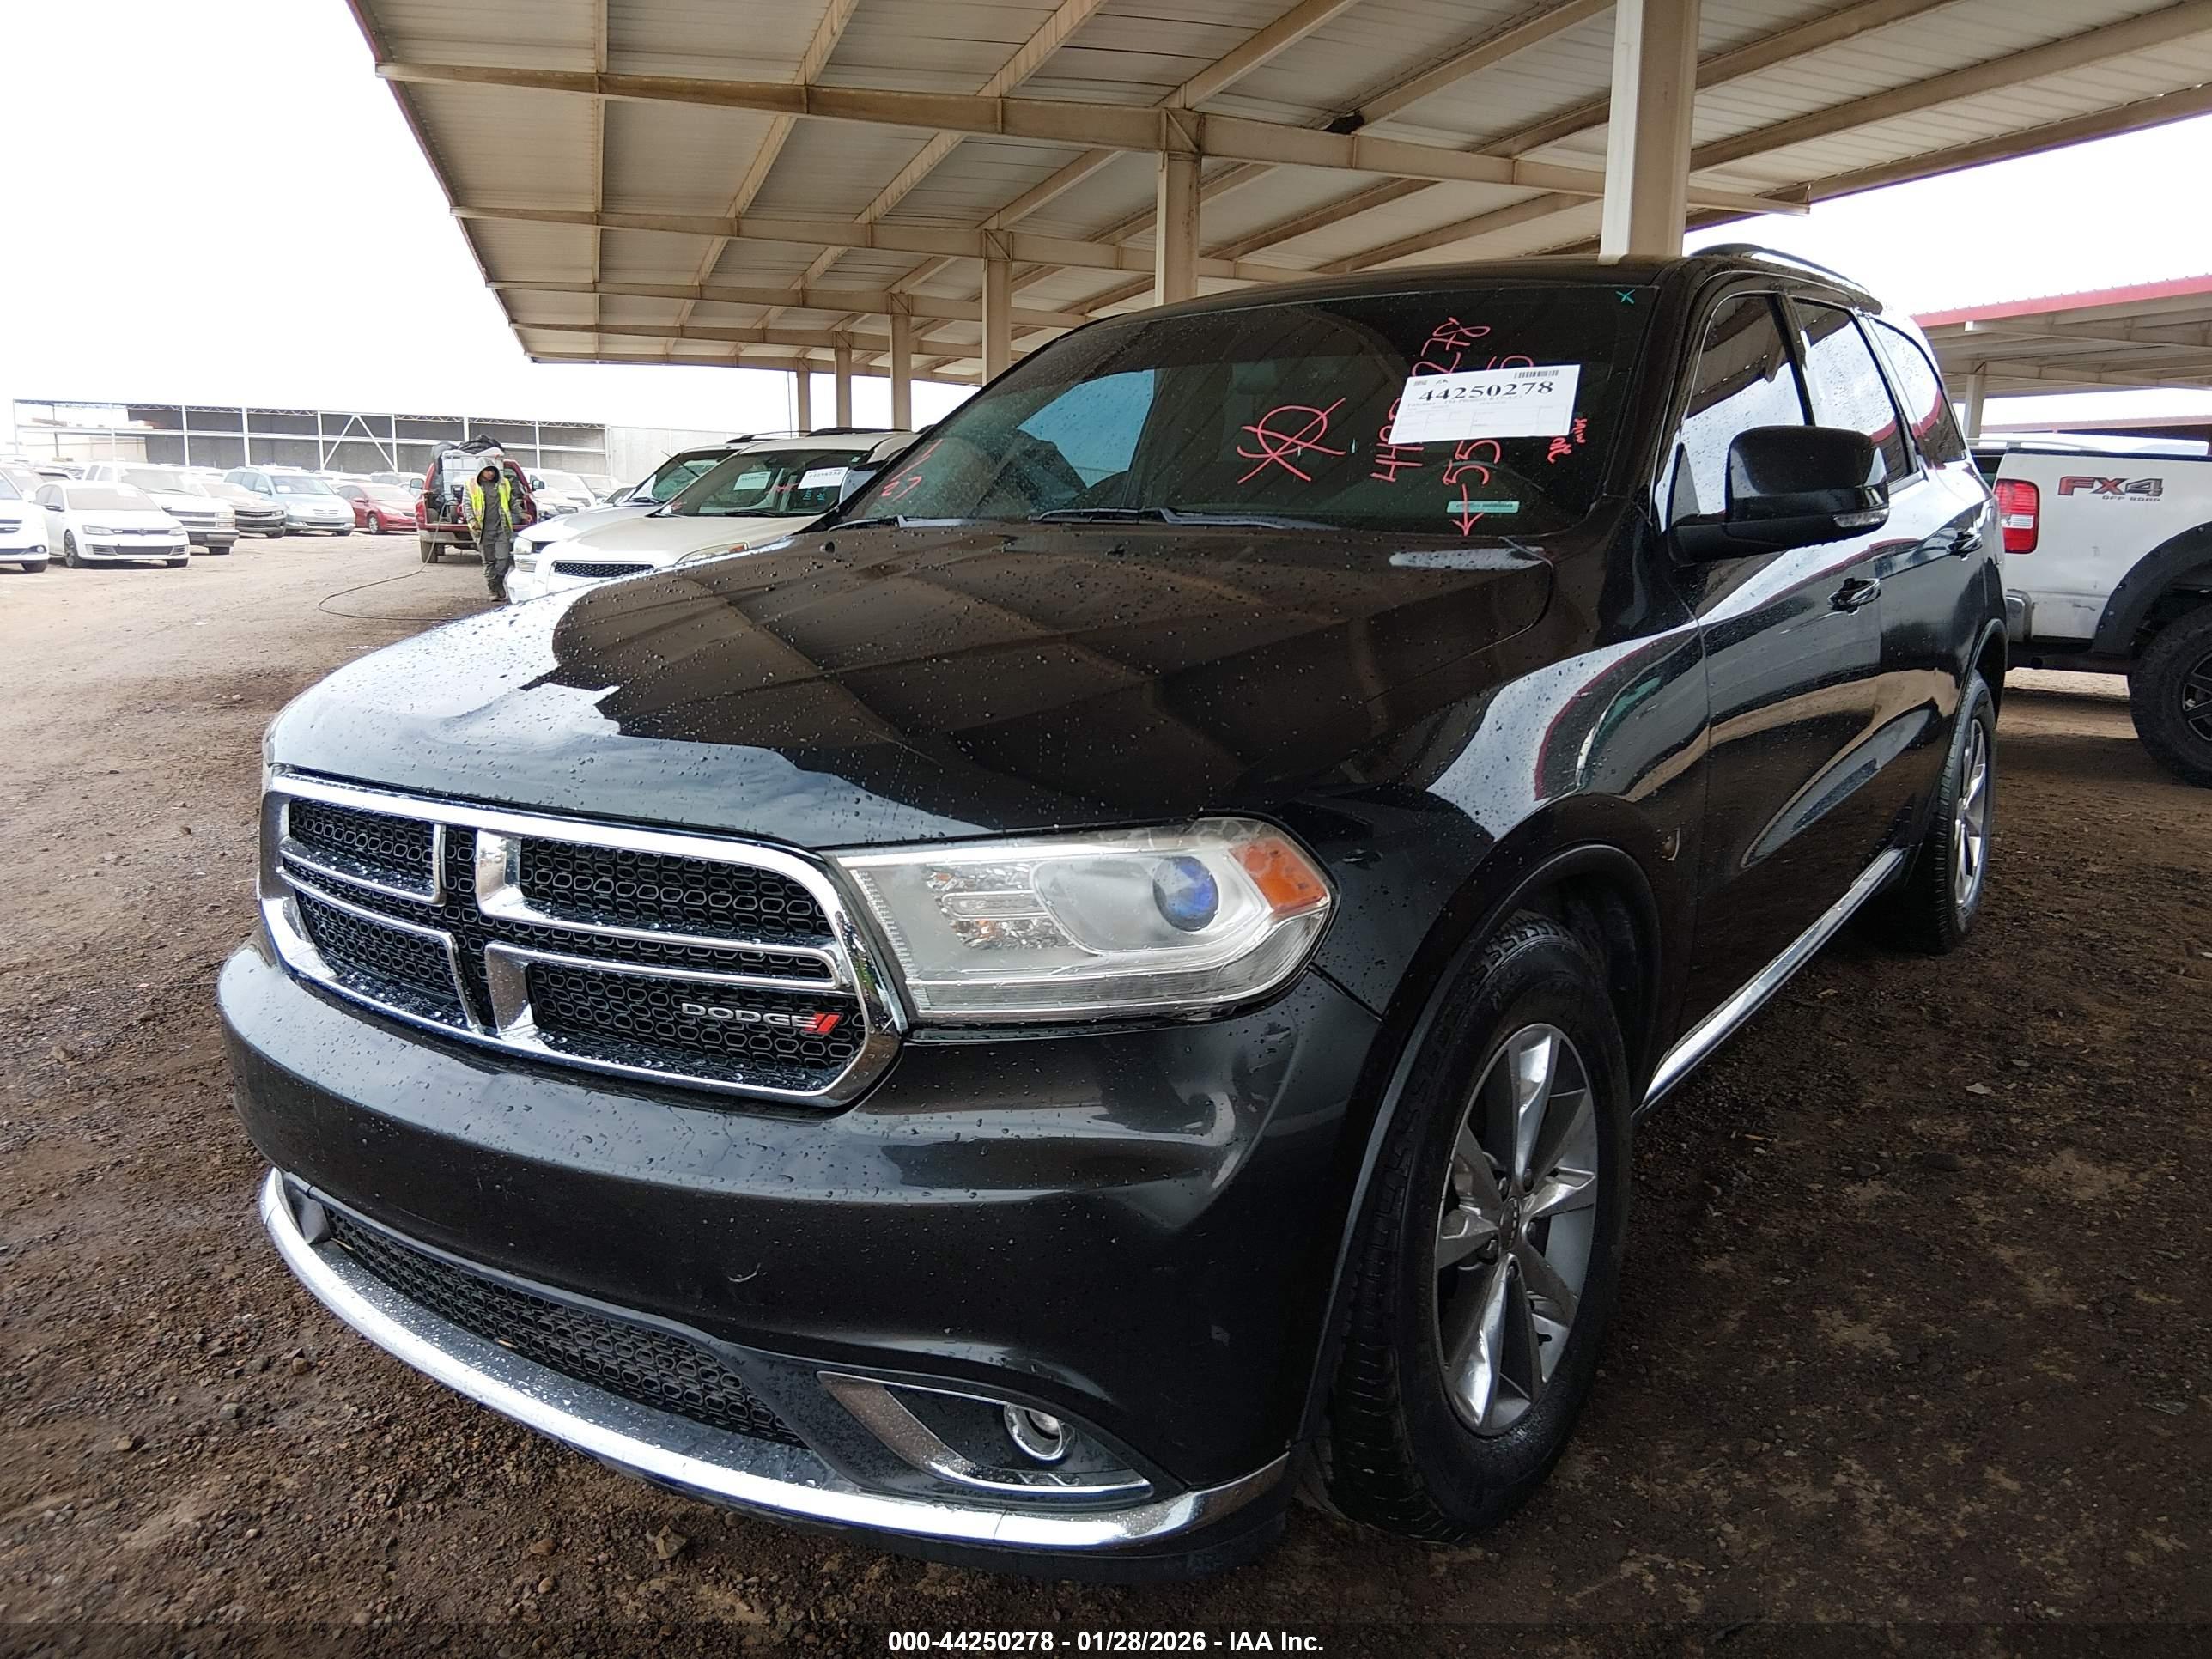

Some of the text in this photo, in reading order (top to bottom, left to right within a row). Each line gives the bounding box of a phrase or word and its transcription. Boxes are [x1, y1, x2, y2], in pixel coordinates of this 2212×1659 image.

[1419, 380, 1553, 402] 44250278
[2057, 476, 2164, 497] FX4
[681, 1002, 818, 1029] DODGE
